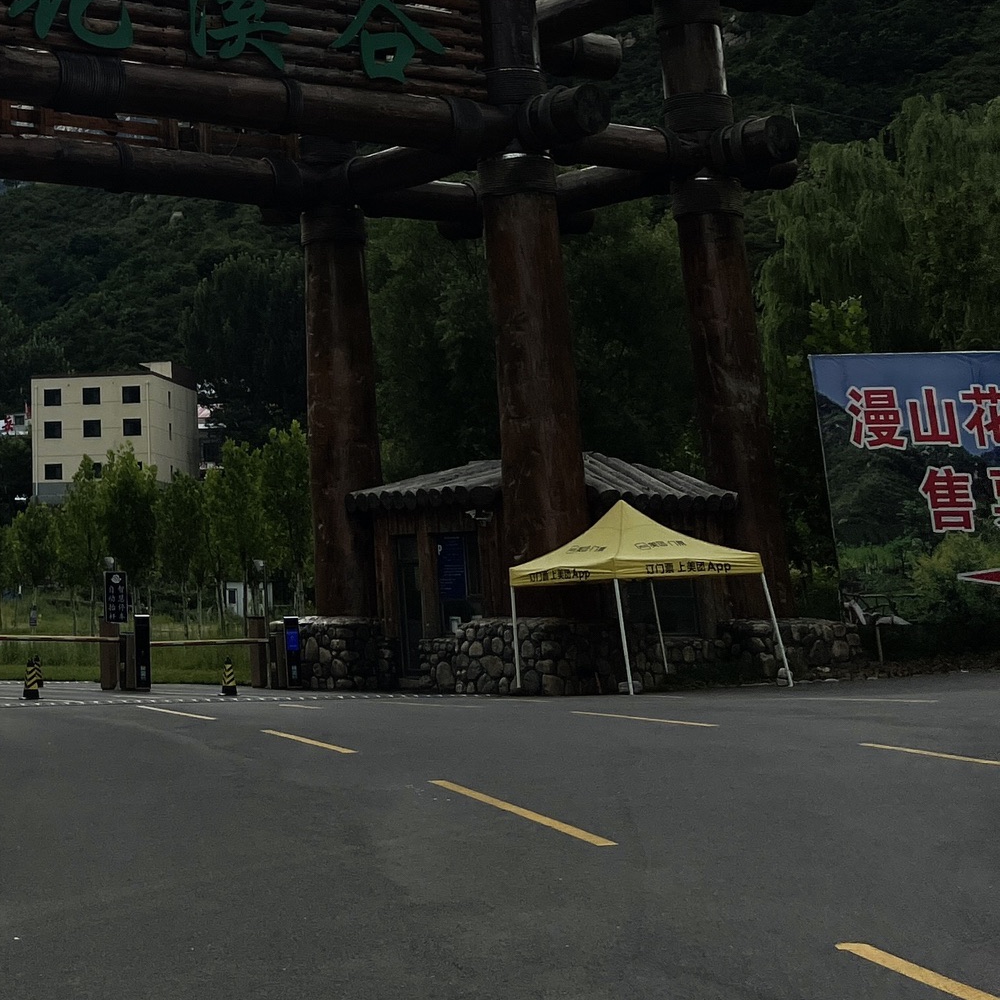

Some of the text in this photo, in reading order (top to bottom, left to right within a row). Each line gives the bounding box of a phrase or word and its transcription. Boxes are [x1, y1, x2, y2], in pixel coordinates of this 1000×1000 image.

[918, 465, 1000, 533] 售
[646, 562, 674, 574] 订门票
